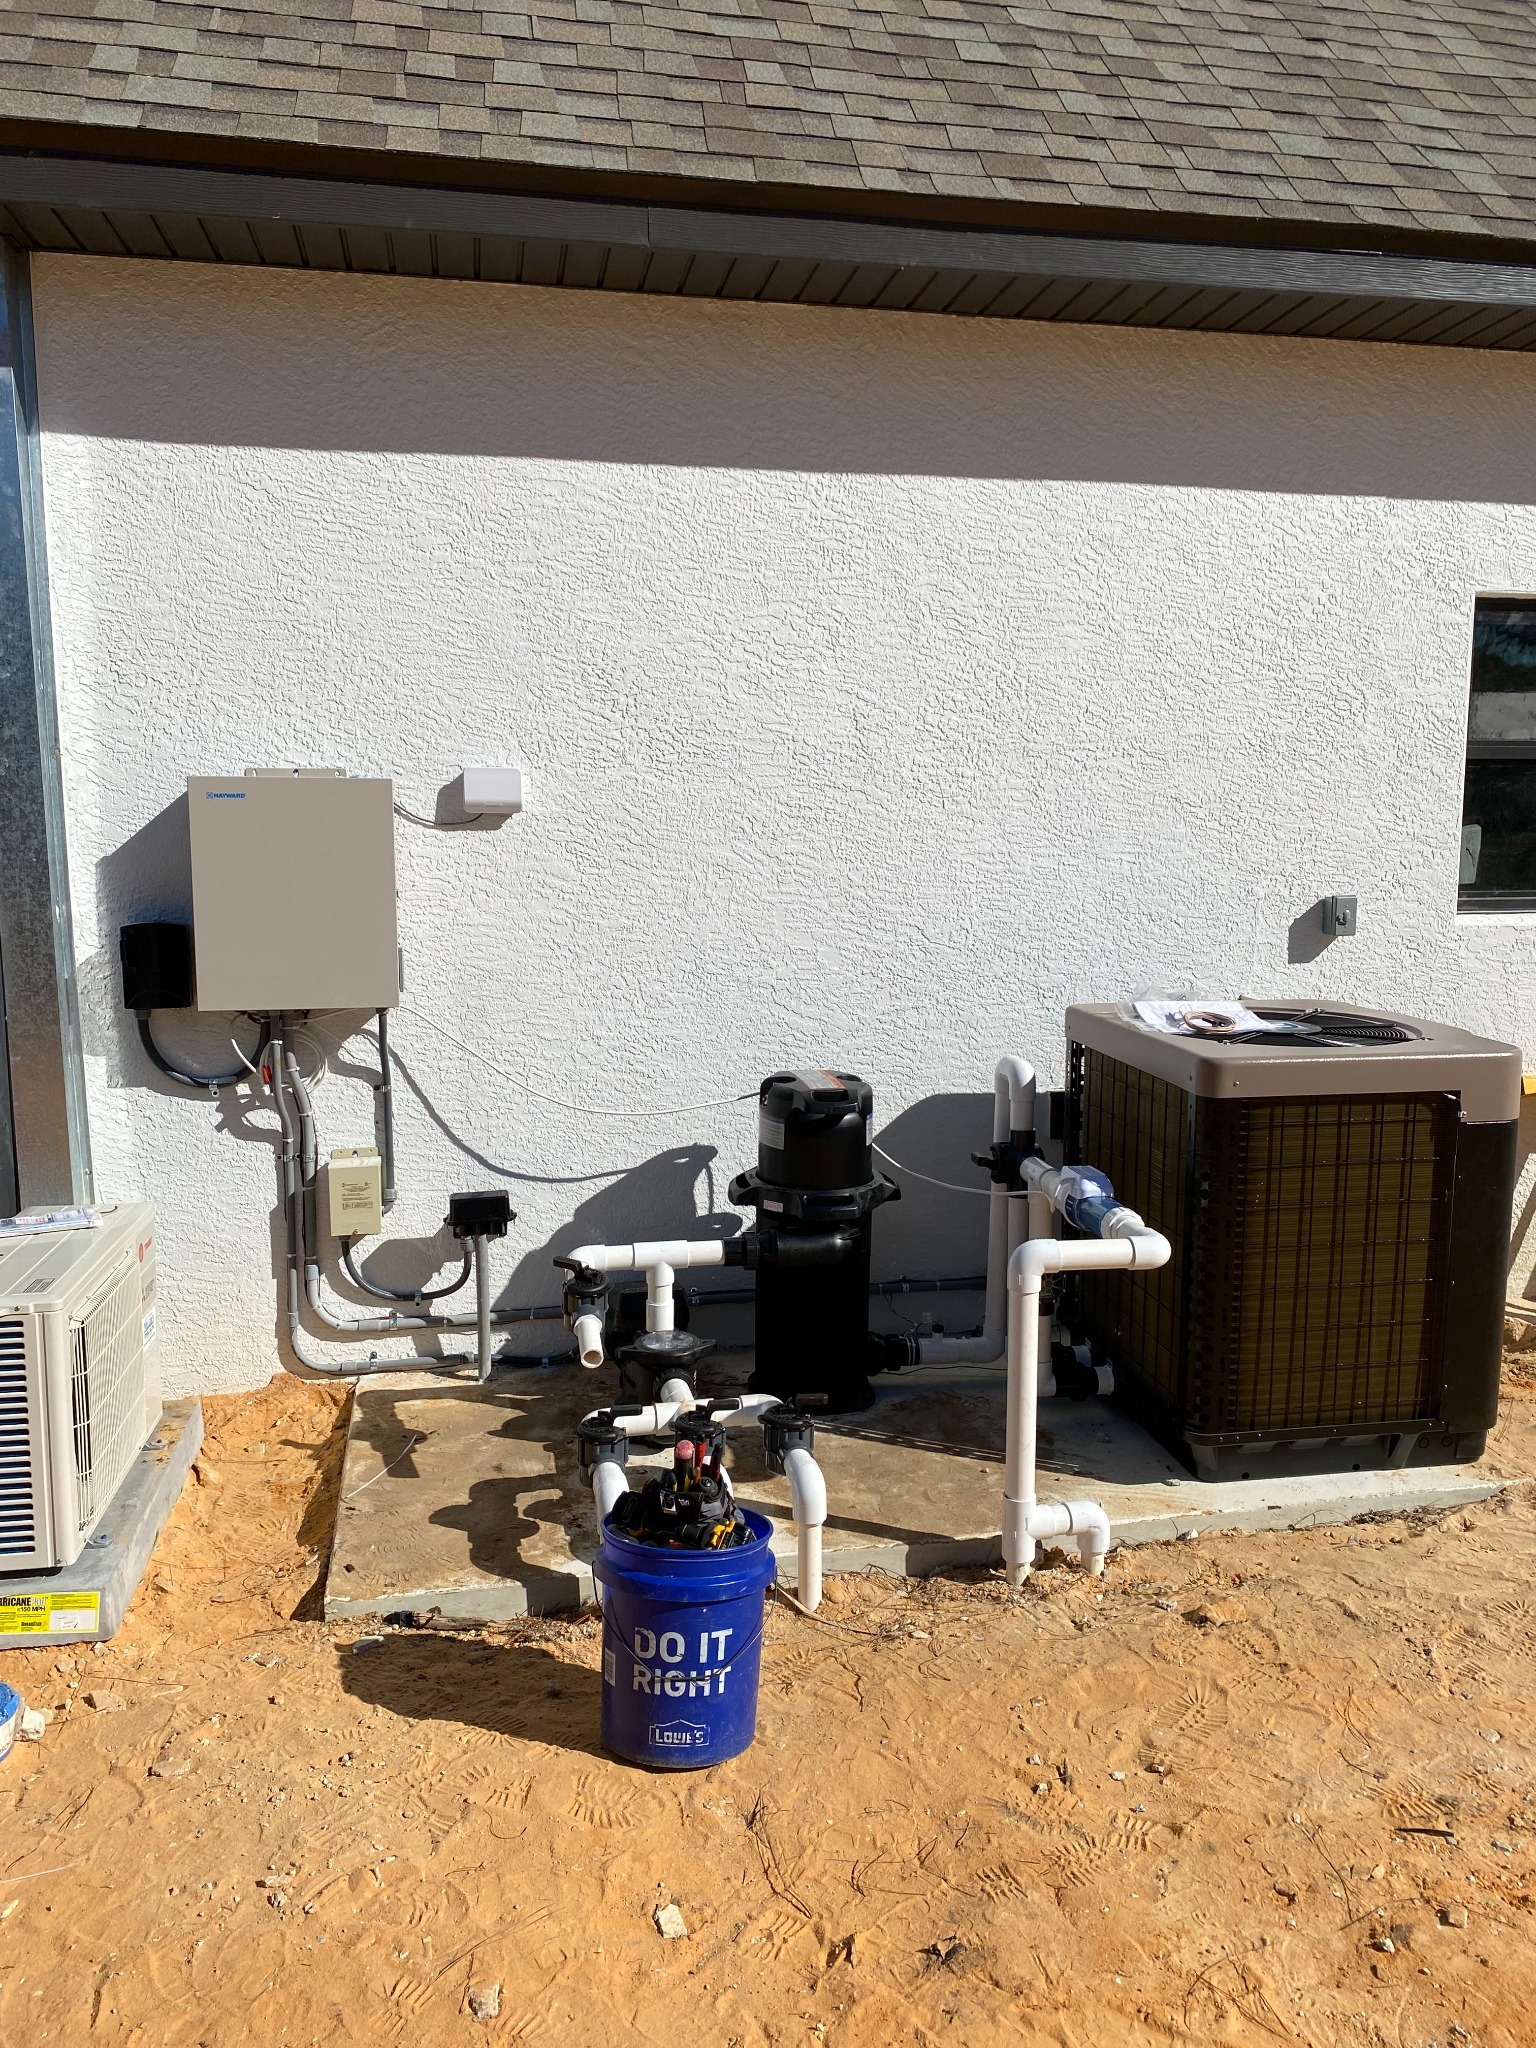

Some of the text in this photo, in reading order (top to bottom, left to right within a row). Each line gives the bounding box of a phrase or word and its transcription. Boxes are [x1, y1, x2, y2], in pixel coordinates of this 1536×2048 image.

[634, 1627, 733, 1664] DO IT
[633, 1663, 732, 1697] RIGHT
